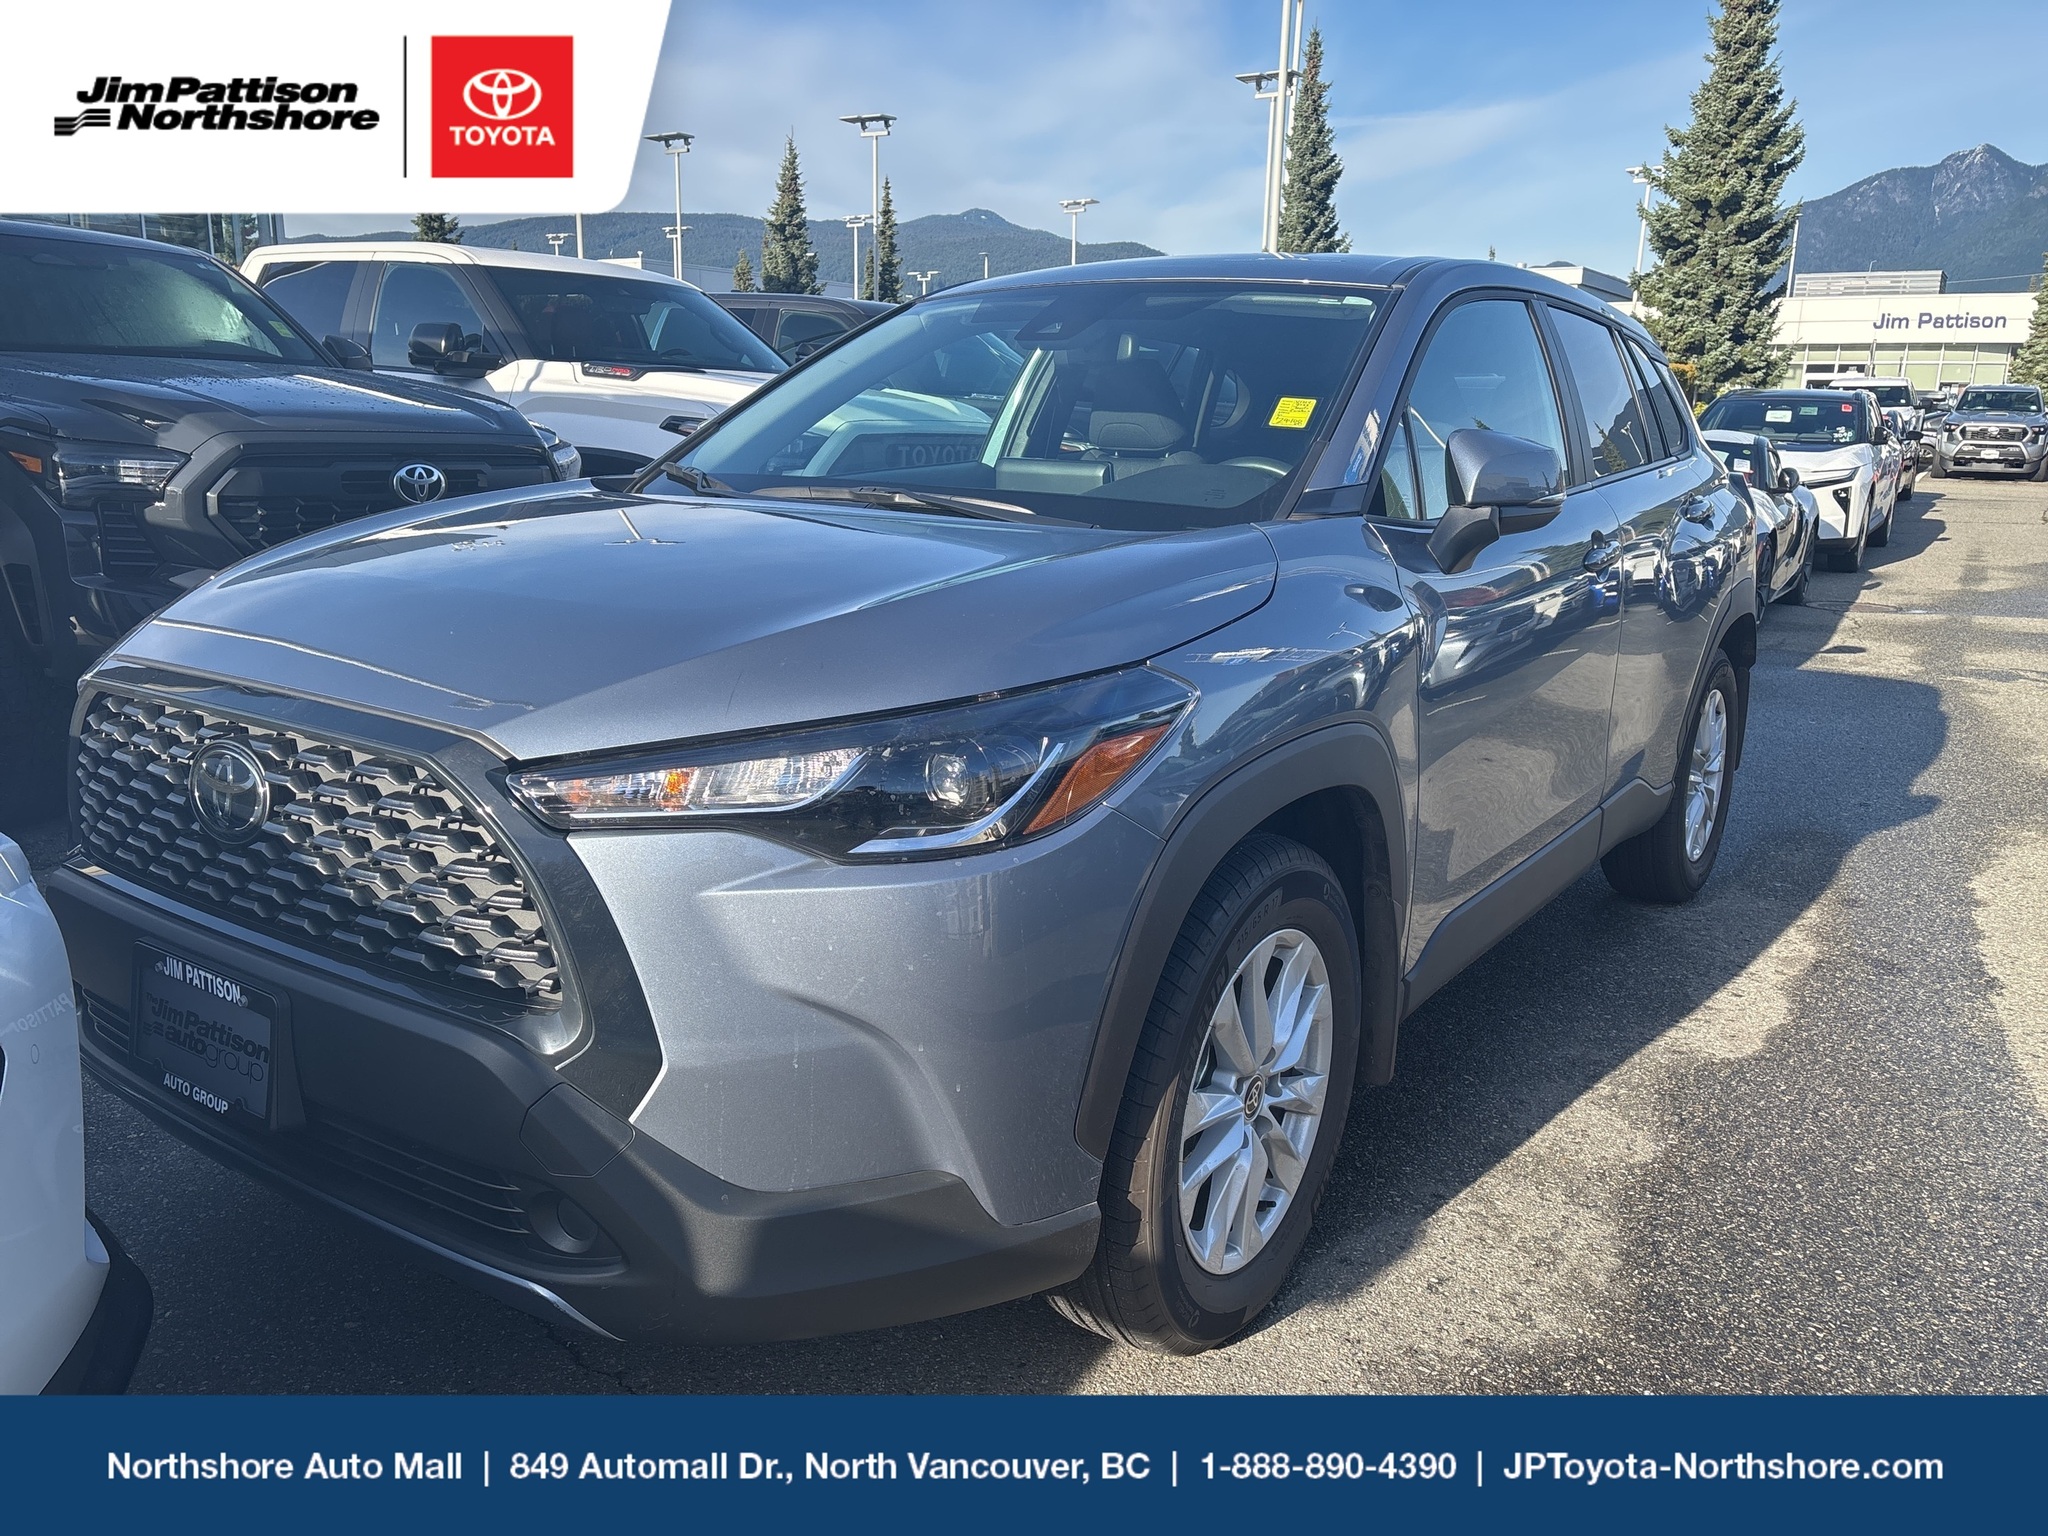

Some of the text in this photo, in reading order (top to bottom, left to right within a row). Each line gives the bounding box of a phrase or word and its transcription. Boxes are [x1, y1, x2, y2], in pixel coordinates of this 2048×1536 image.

[1873, 311, 2007, 329] Jim Pattison
[163, 956, 241, 1005] JIM PATTISON
[163, 1072, 229, 1114] AUTO GROUP
